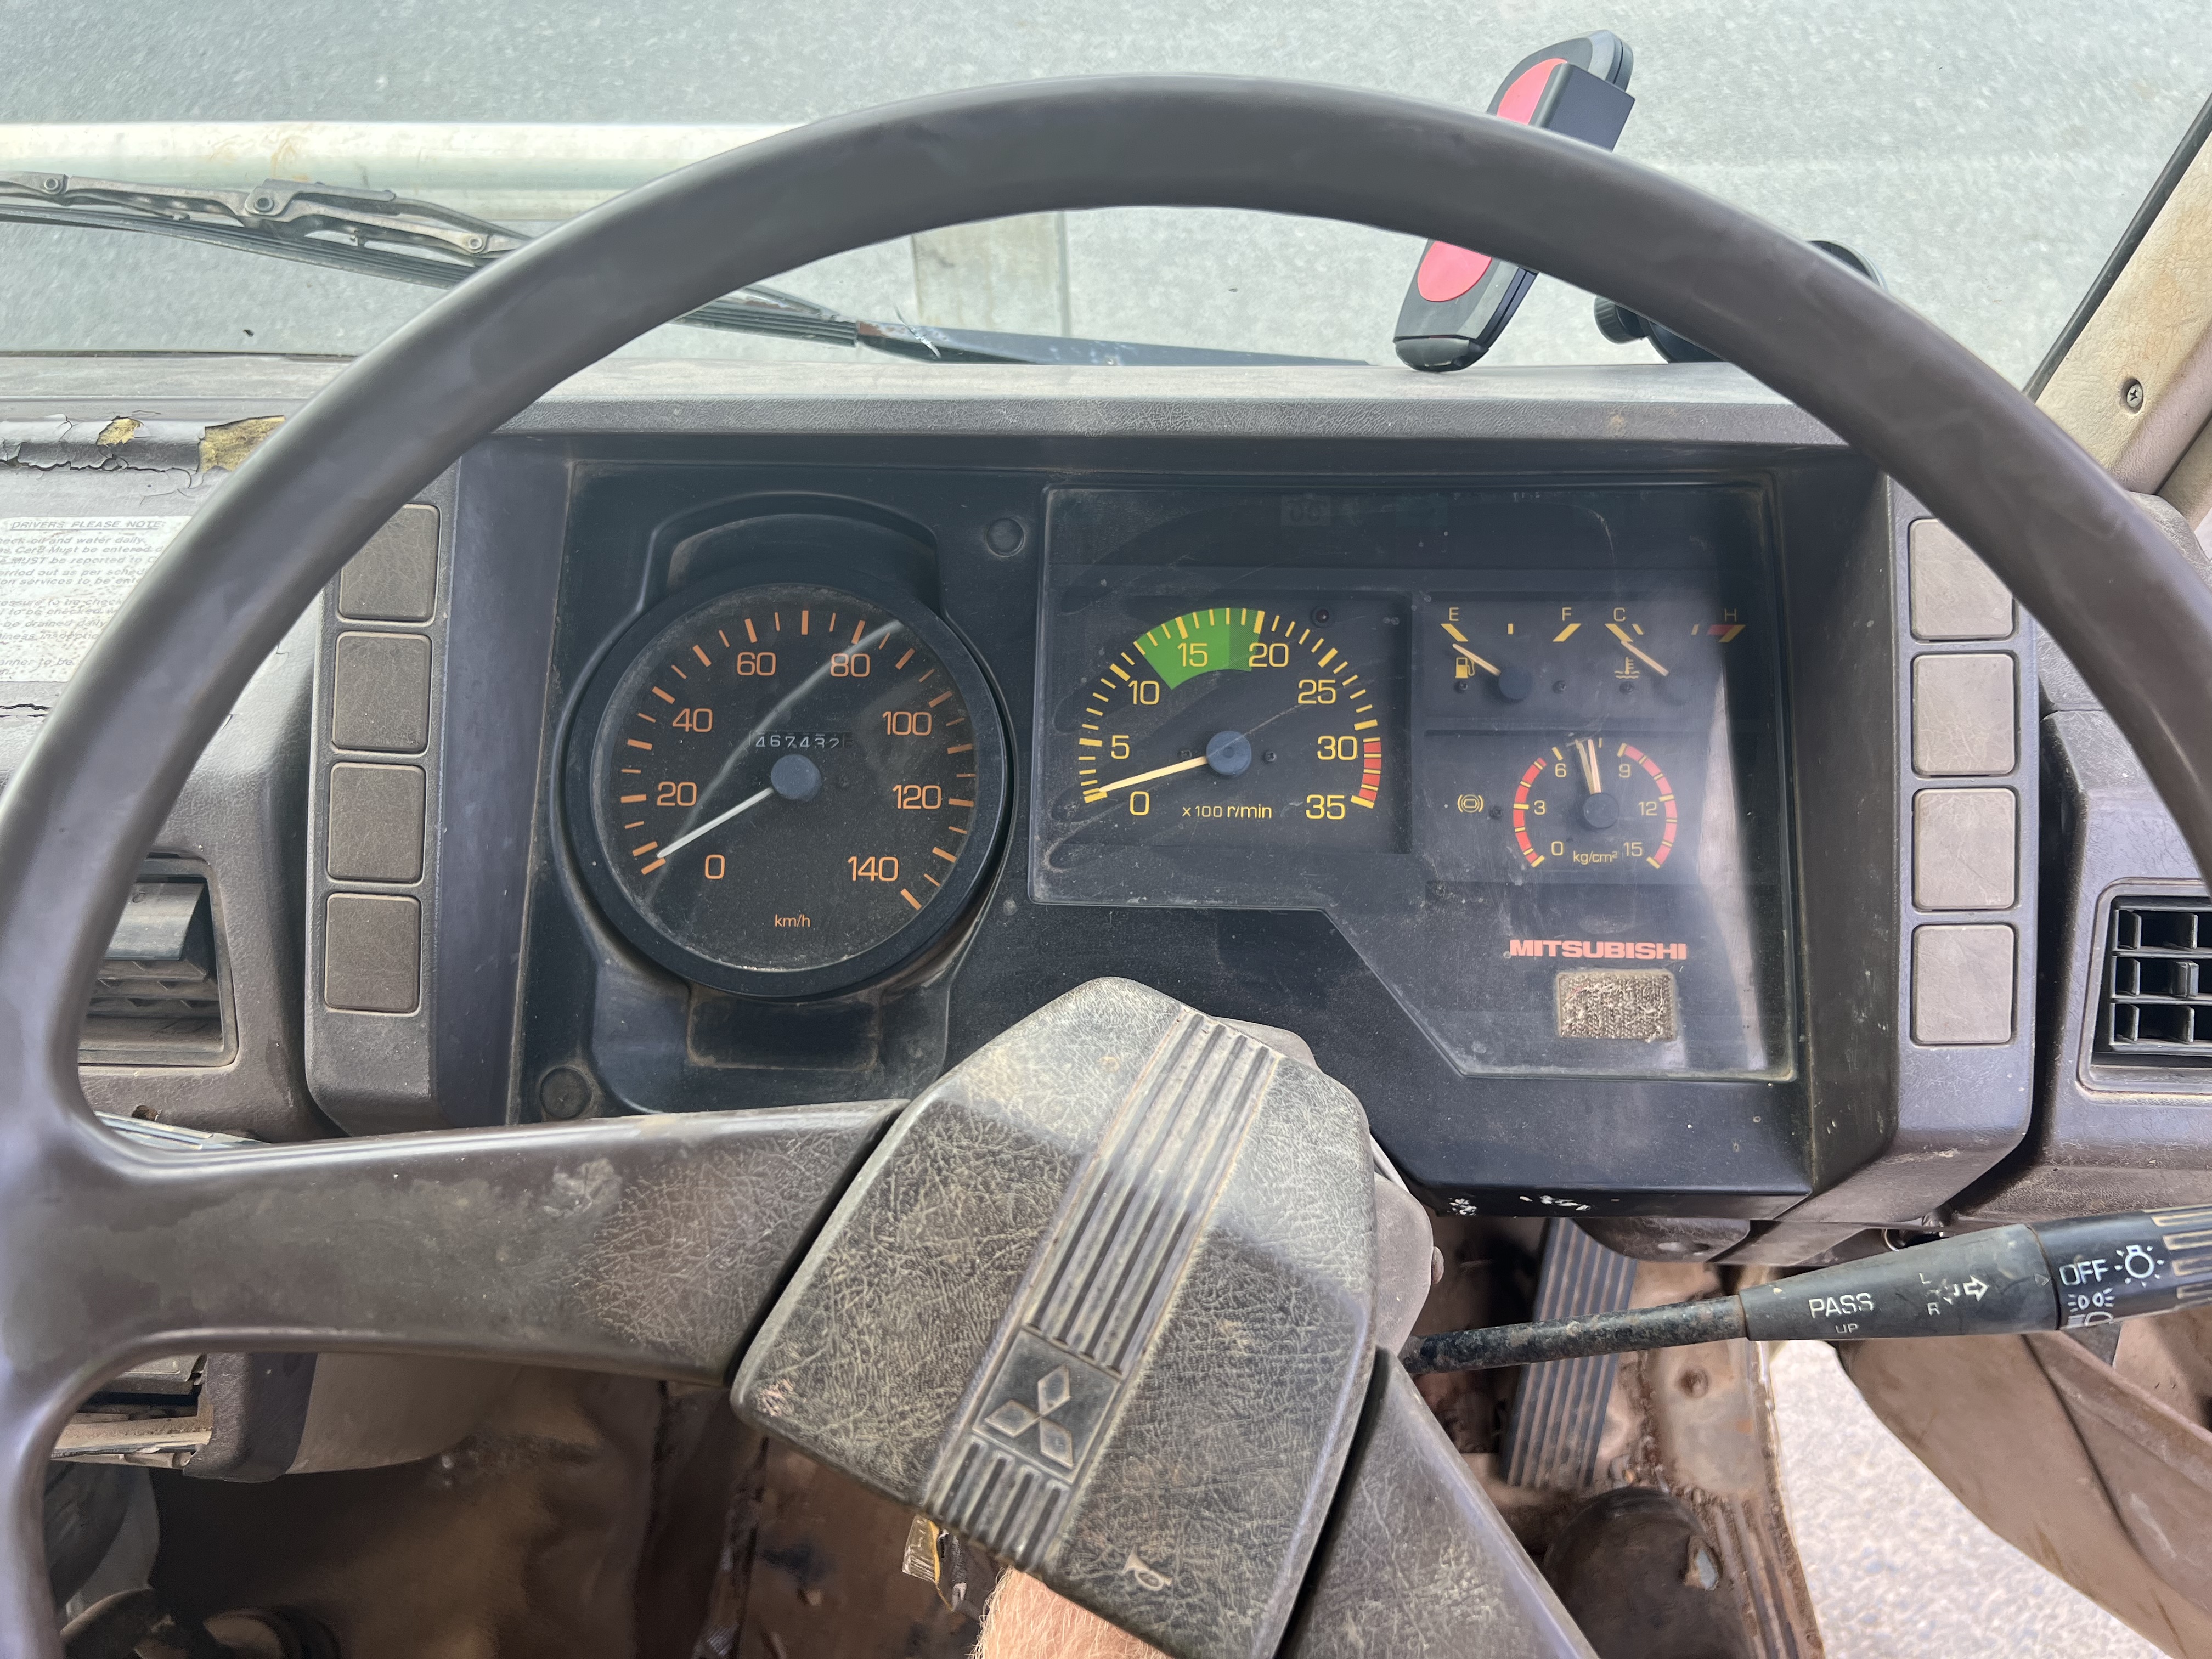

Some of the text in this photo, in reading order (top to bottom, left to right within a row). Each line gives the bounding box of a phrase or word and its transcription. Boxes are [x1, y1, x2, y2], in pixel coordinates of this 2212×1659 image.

[76, 536, 111, 544] water
[70, 556, 126, 565] reported
[81, 569, 104, 577] per
[94, 576, 111, 585] be
[1449, 607, 1459, 622] E
[1562, 607, 1572, 621] F
[1613, 607, 1627, 622] C
[1724, 608, 1738, 622] H
[25, 619, 75, 627] drained
[38, 657, 53, 665] to
[1177, 642, 1208, 667] 15
[1249, 642, 1289, 667] 20
[737, 652, 776, 676] 60
[831, 653, 870, 678] 80
[1128, 680, 1160, 705] 10
[1298, 679, 1336, 704] 25
[672, 708, 713, 732] 40
[882, 711, 932, 736] 100
[1111, 735, 1130, 760] 5
[1317, 736, 1358, 760] 30
[1555, 763, 1567, 778] 6
[1619, 764, 1631, 778] 9
[657, 781, 697, 806] 20
[893, 785, 941, 809] 120
[1130, 791, 1150, 816] 0
[1306, 794, 1346, 820] 35
[1534, 800, 1546, 815] 3
[1638, 801, 1657, 816] 12
[1227, 804, 1273, 819] r/min
[1551, 840, 1564, 856] 0
[1623, 842, 1643, 857] 15
[704, 854, 726, 880] 0
[848, 856, 899, 882] 140
[774, 913, 811, 928] km/h
[1509, 939, 1687, 960] MITSUBISHI
[1918, 1272, 1932, 1285] L
[2059, 1258, 2108, 1285] OFF
[1808, 1292, 1874, 1319] PASS
[1927, 1302, 1941, 1316] R
[1835, 1323, 1859, 1334] UP
